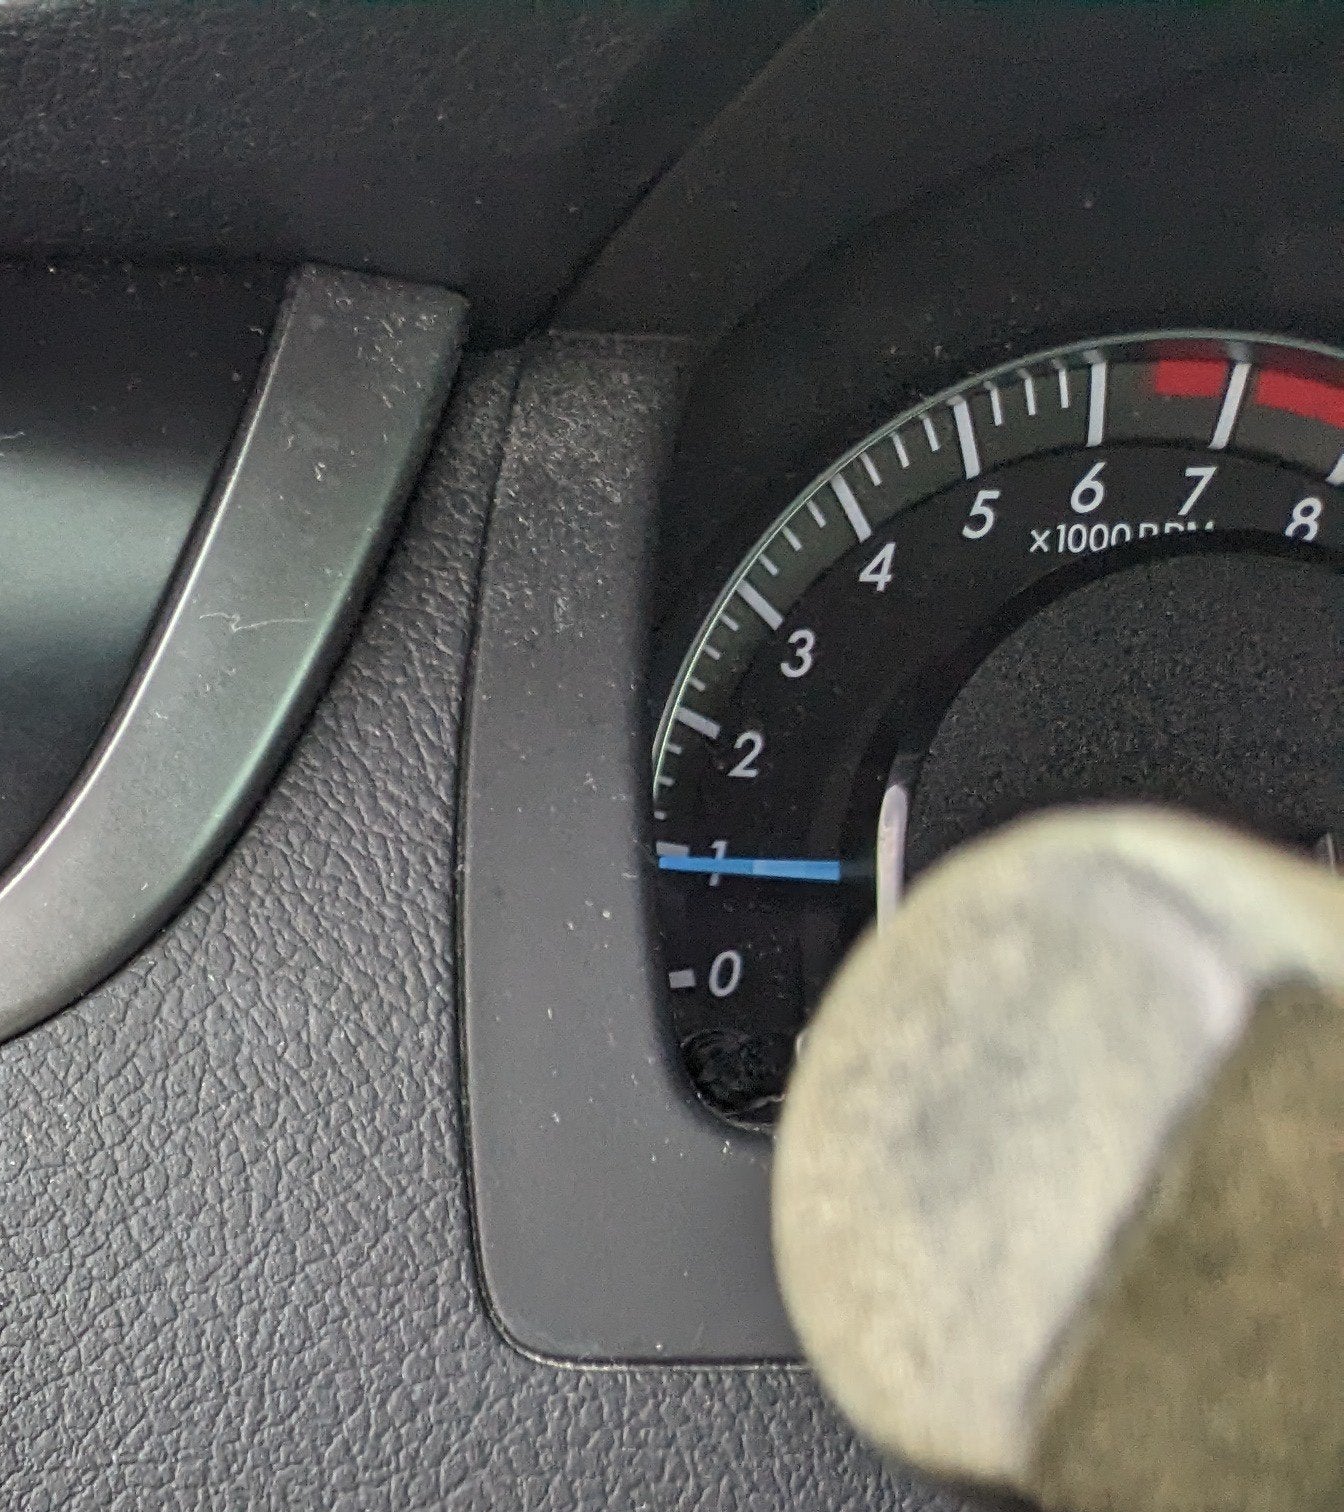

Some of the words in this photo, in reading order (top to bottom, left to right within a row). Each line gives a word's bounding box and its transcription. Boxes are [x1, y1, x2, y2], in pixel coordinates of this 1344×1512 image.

[1070, 461, 1106, 514] 6
[1178, 466, 1218, 516] 7
[962, 489, 1001, 540] 5
[1285, 496, 1323, 541] 8
[858, 542, 896, 592] 4
[780, 629, 815, 678] 3
[728, 731, 764, 778] 2
[708, 840, 729, 887] 1
[709, 950, 742, 997] 0
